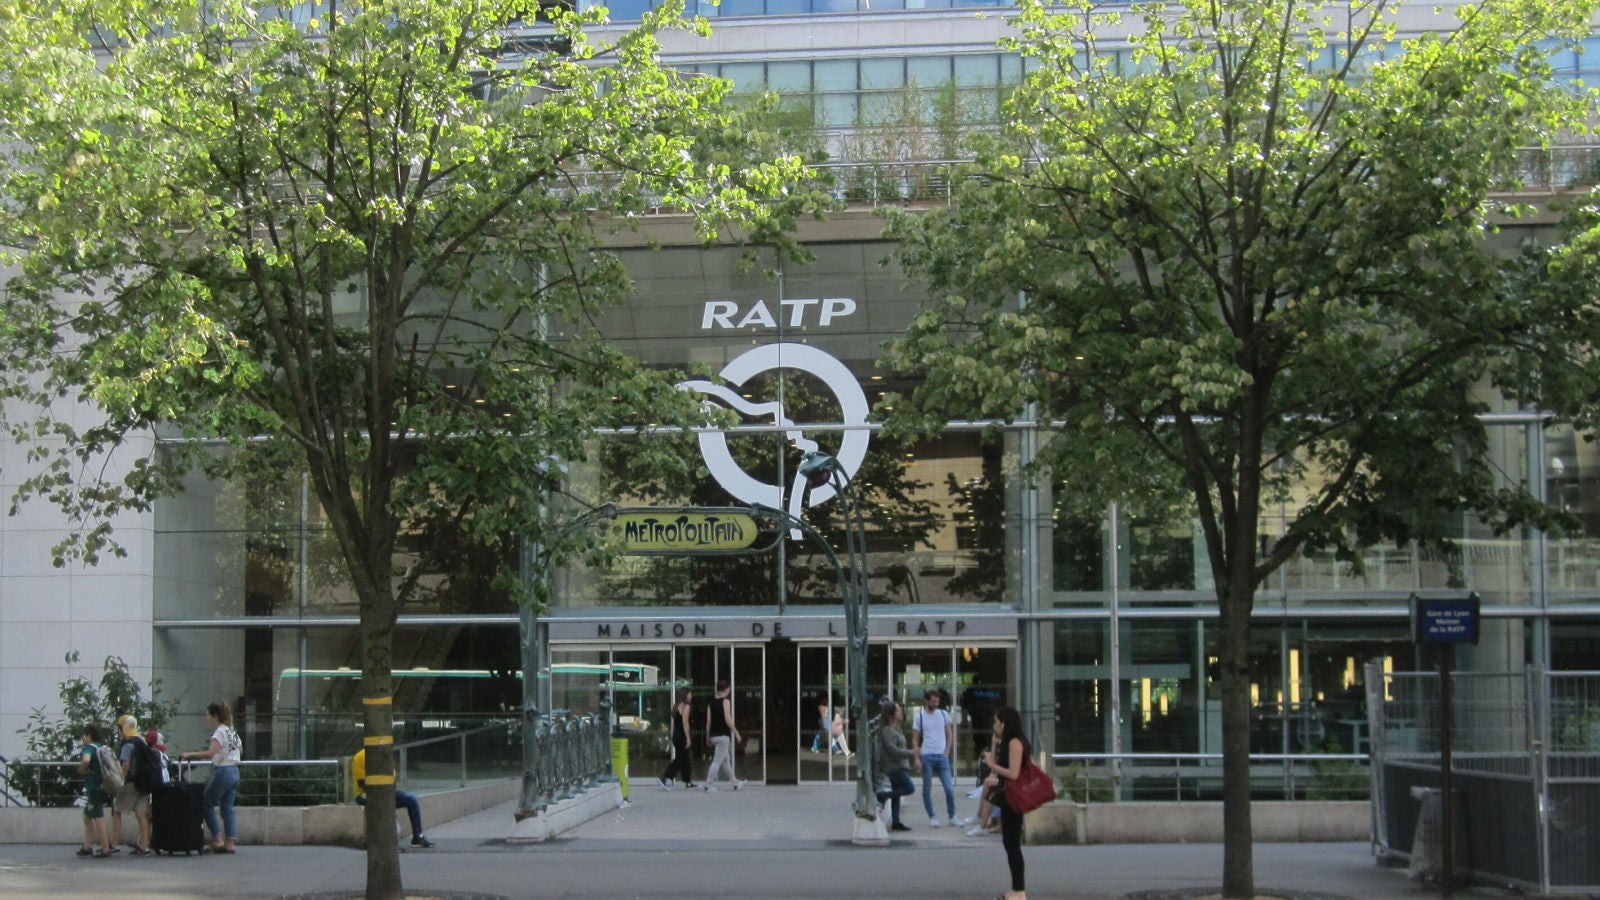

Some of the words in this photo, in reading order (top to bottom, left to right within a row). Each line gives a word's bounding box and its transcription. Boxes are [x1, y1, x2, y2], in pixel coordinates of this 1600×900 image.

[701, 298, 857, 329] RATP
[624, 515, 744, 547] METROPOLITAIN
[597, 623, 707, 637] MAISON
[752, 622, 783, 637] DE
[896, 620, 967, 635] RATP
